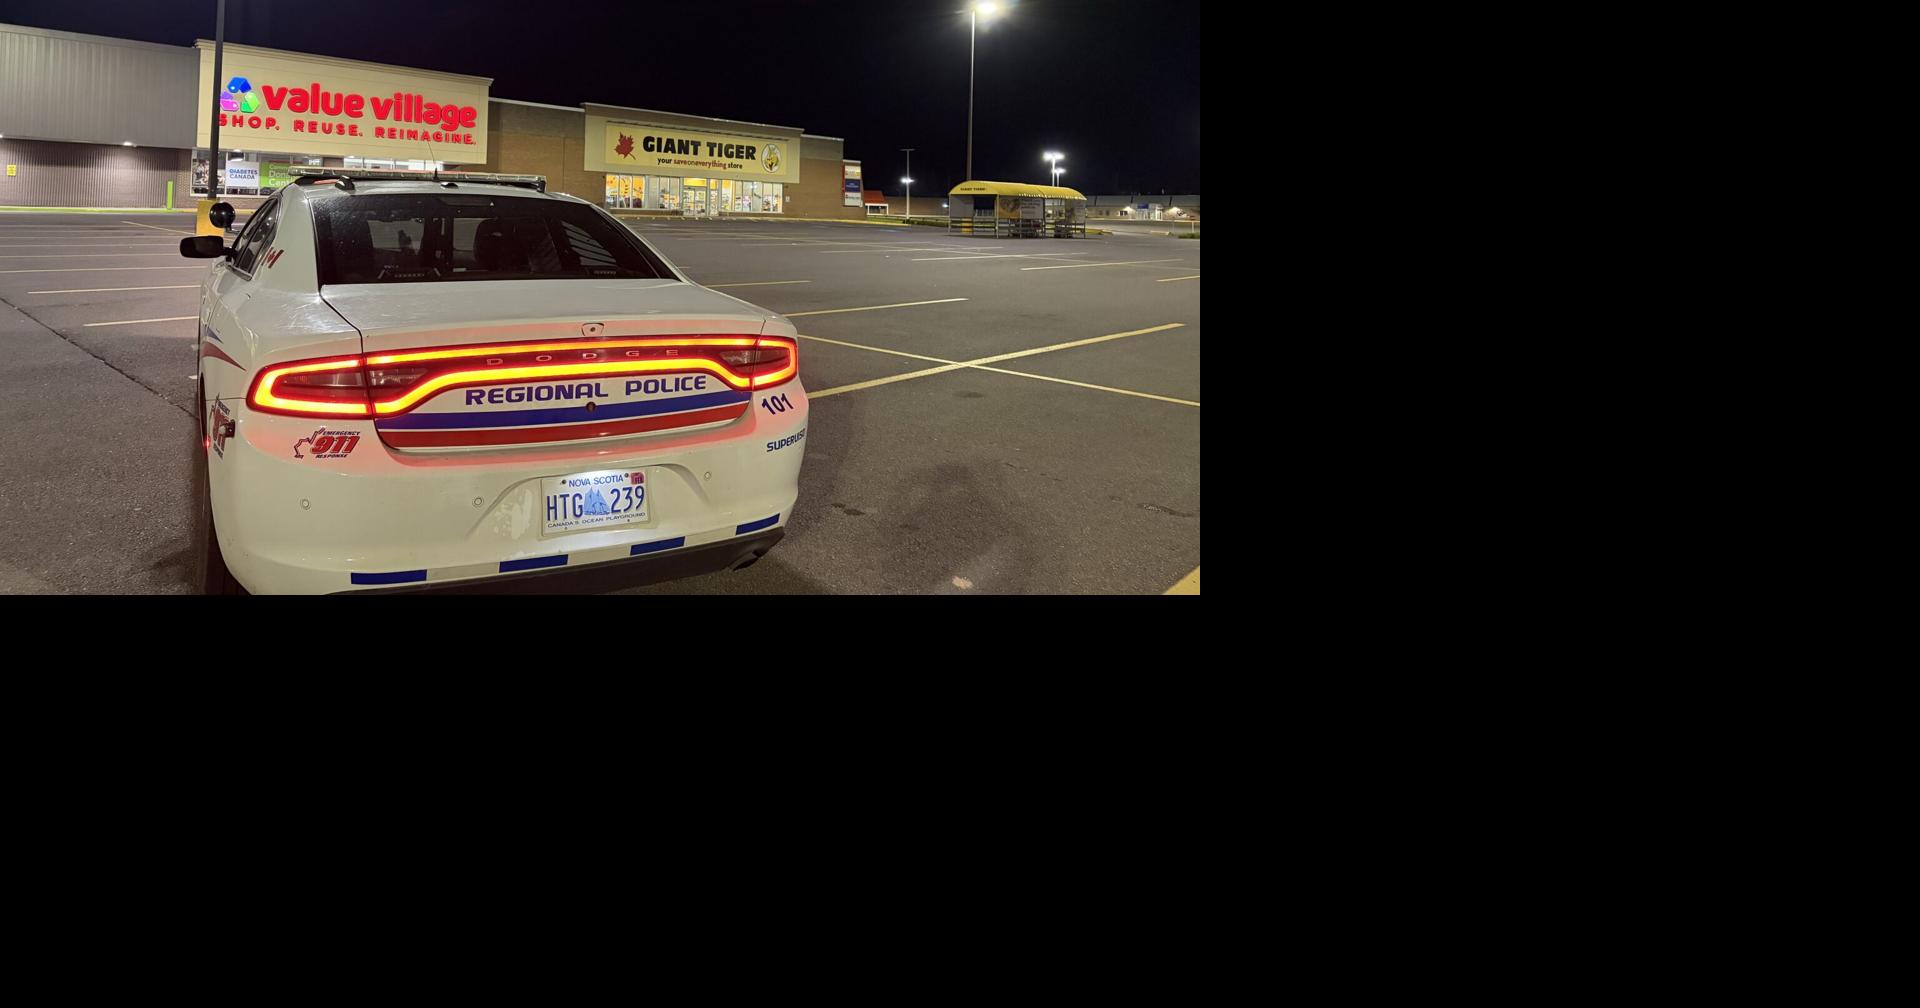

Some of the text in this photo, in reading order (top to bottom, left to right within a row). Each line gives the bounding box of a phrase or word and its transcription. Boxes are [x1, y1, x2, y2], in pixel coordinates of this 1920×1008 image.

[262, 83, 477, 132] value village
[293, 119, 363, 137] REUSE.
[375, 127, 477, 145] REIMAGINE.
[642, 136, 756, 160] GIANT TIGER
[657, 157, 672, 165] your
[465, 375, 706, 406] REGIONAL POLICE
[762, 393, 794, 415] 101
[310, 435, 361, 454] 911
[568, 479, 591, 488] NOVA
[593, 474, 624, 485] SCOTIA
[546, 485, 645, 521] HTG 239
